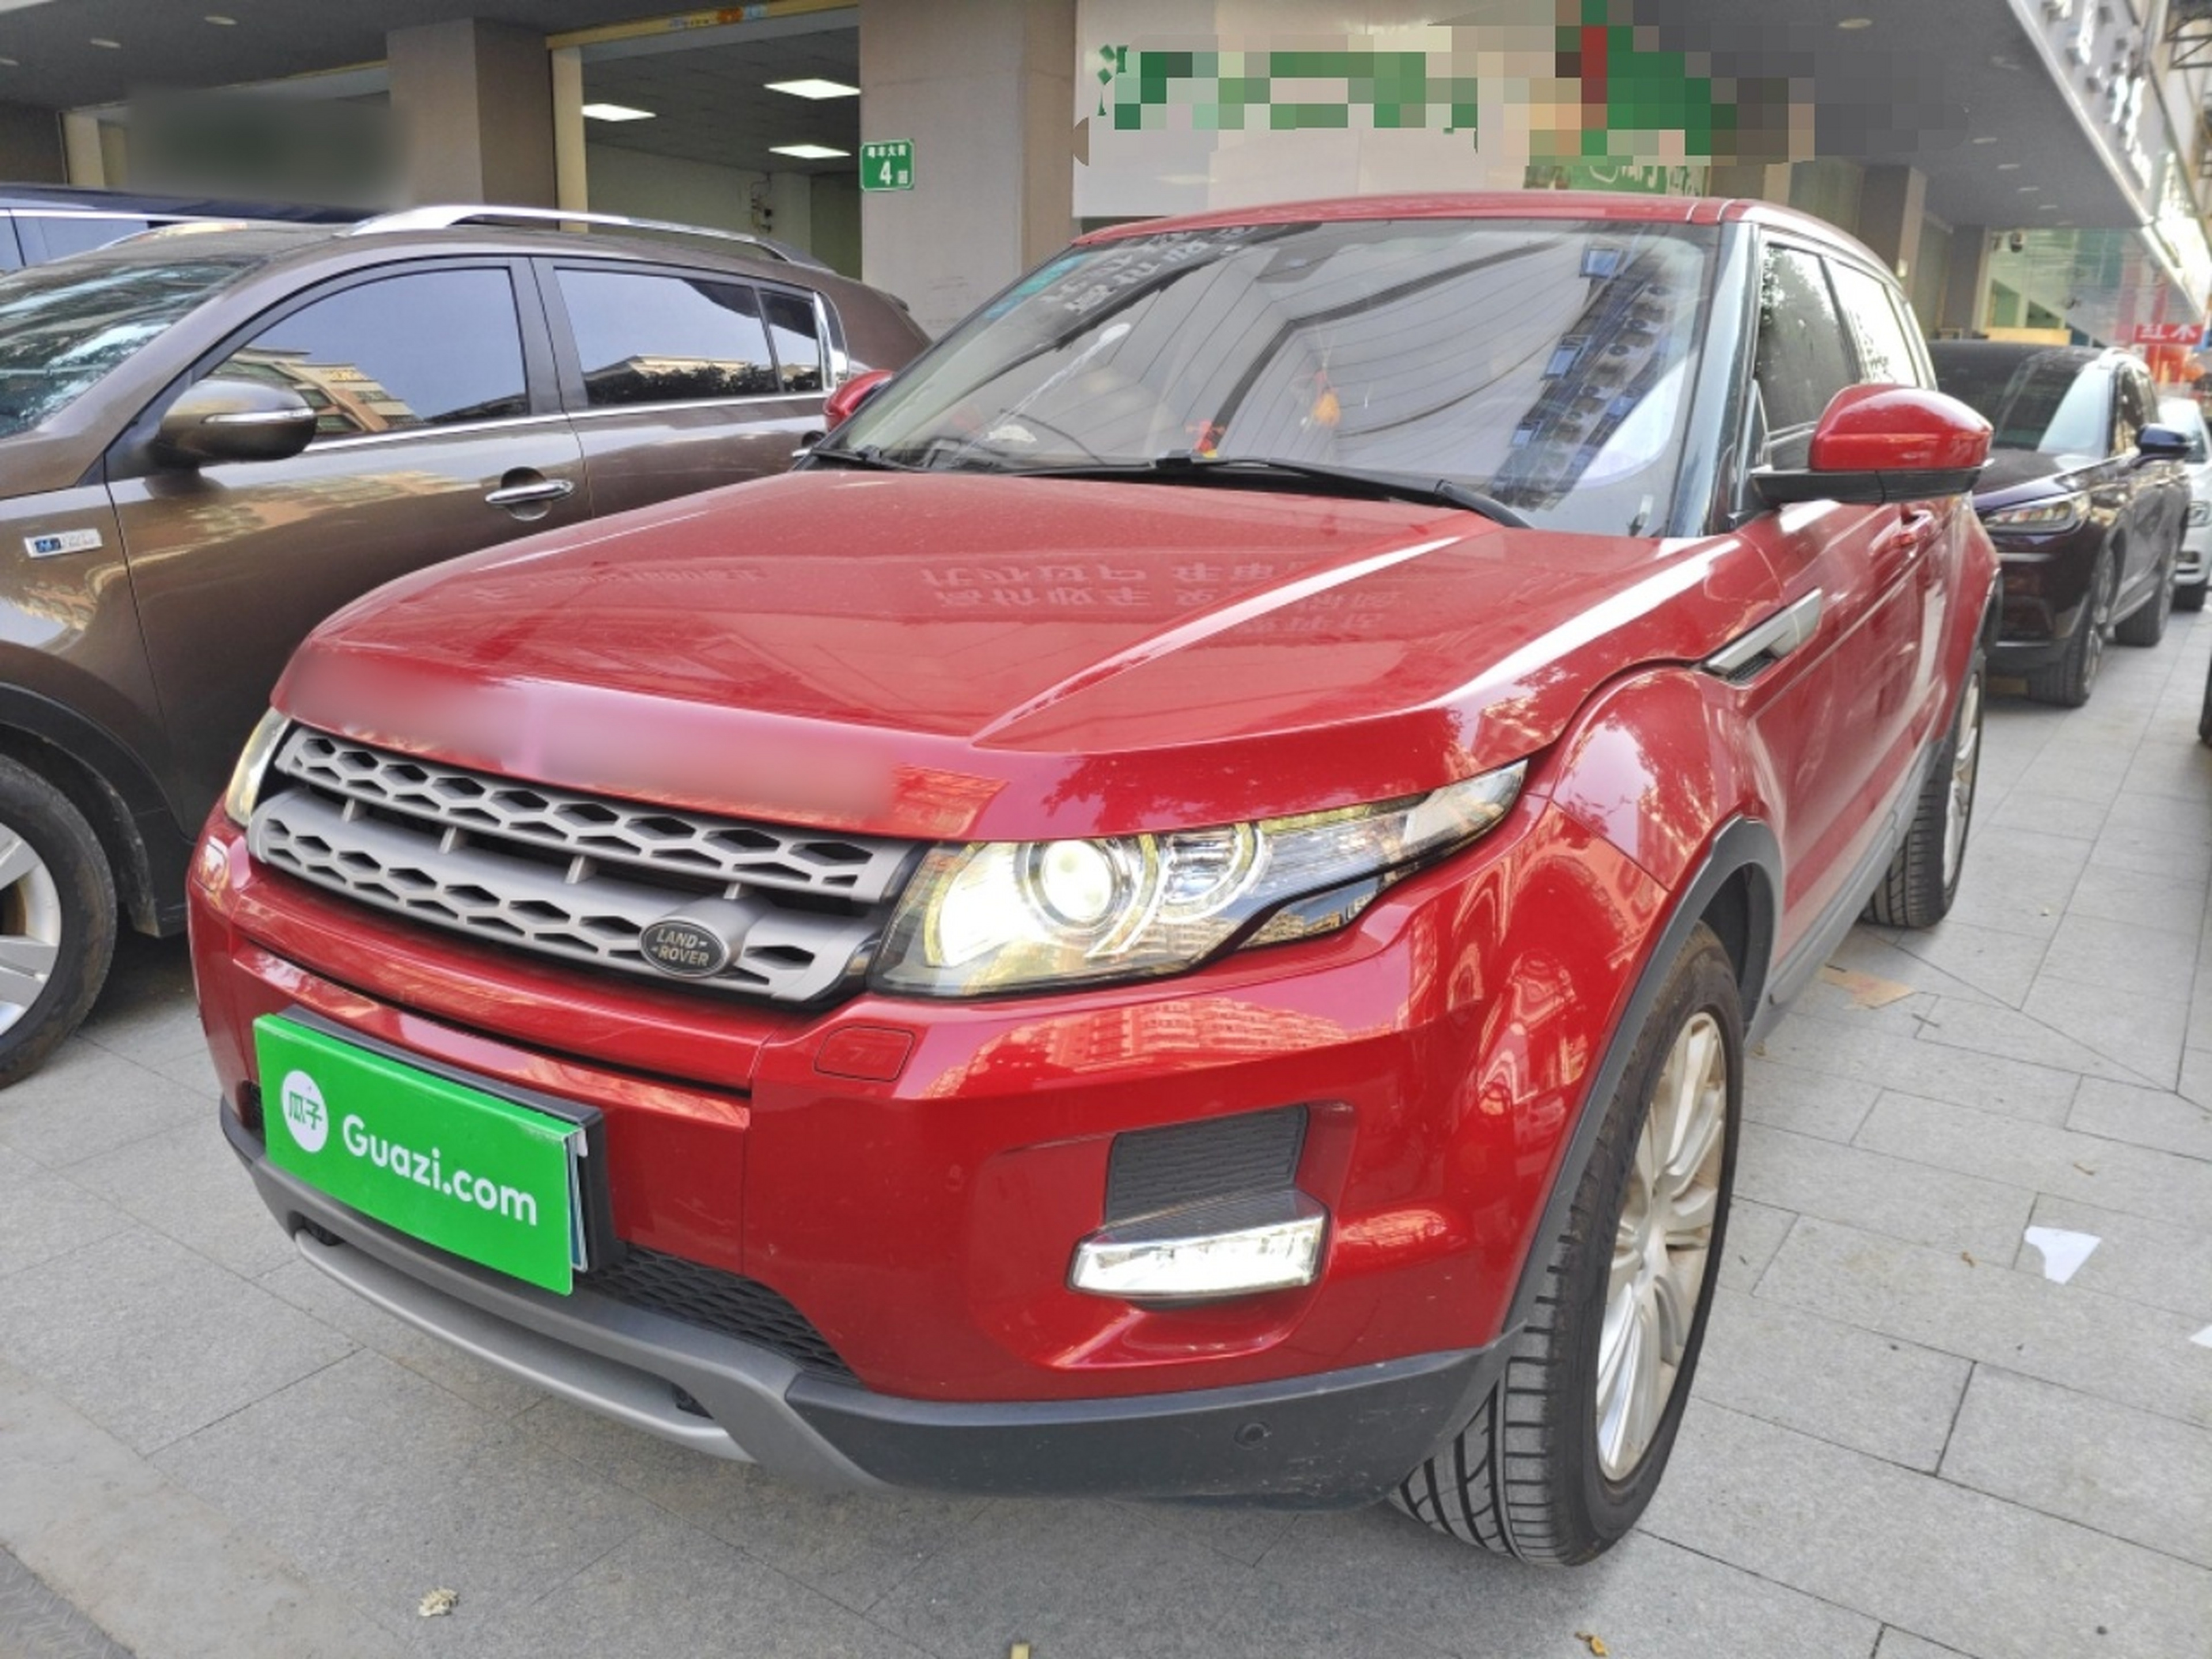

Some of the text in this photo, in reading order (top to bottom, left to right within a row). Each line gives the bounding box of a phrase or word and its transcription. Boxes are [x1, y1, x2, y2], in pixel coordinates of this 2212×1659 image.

[879, 160, 892, 185] 4
[287, 1090, 323, 1131] 瓜子
[342, 1113, 538, 1228] Guazi.com
